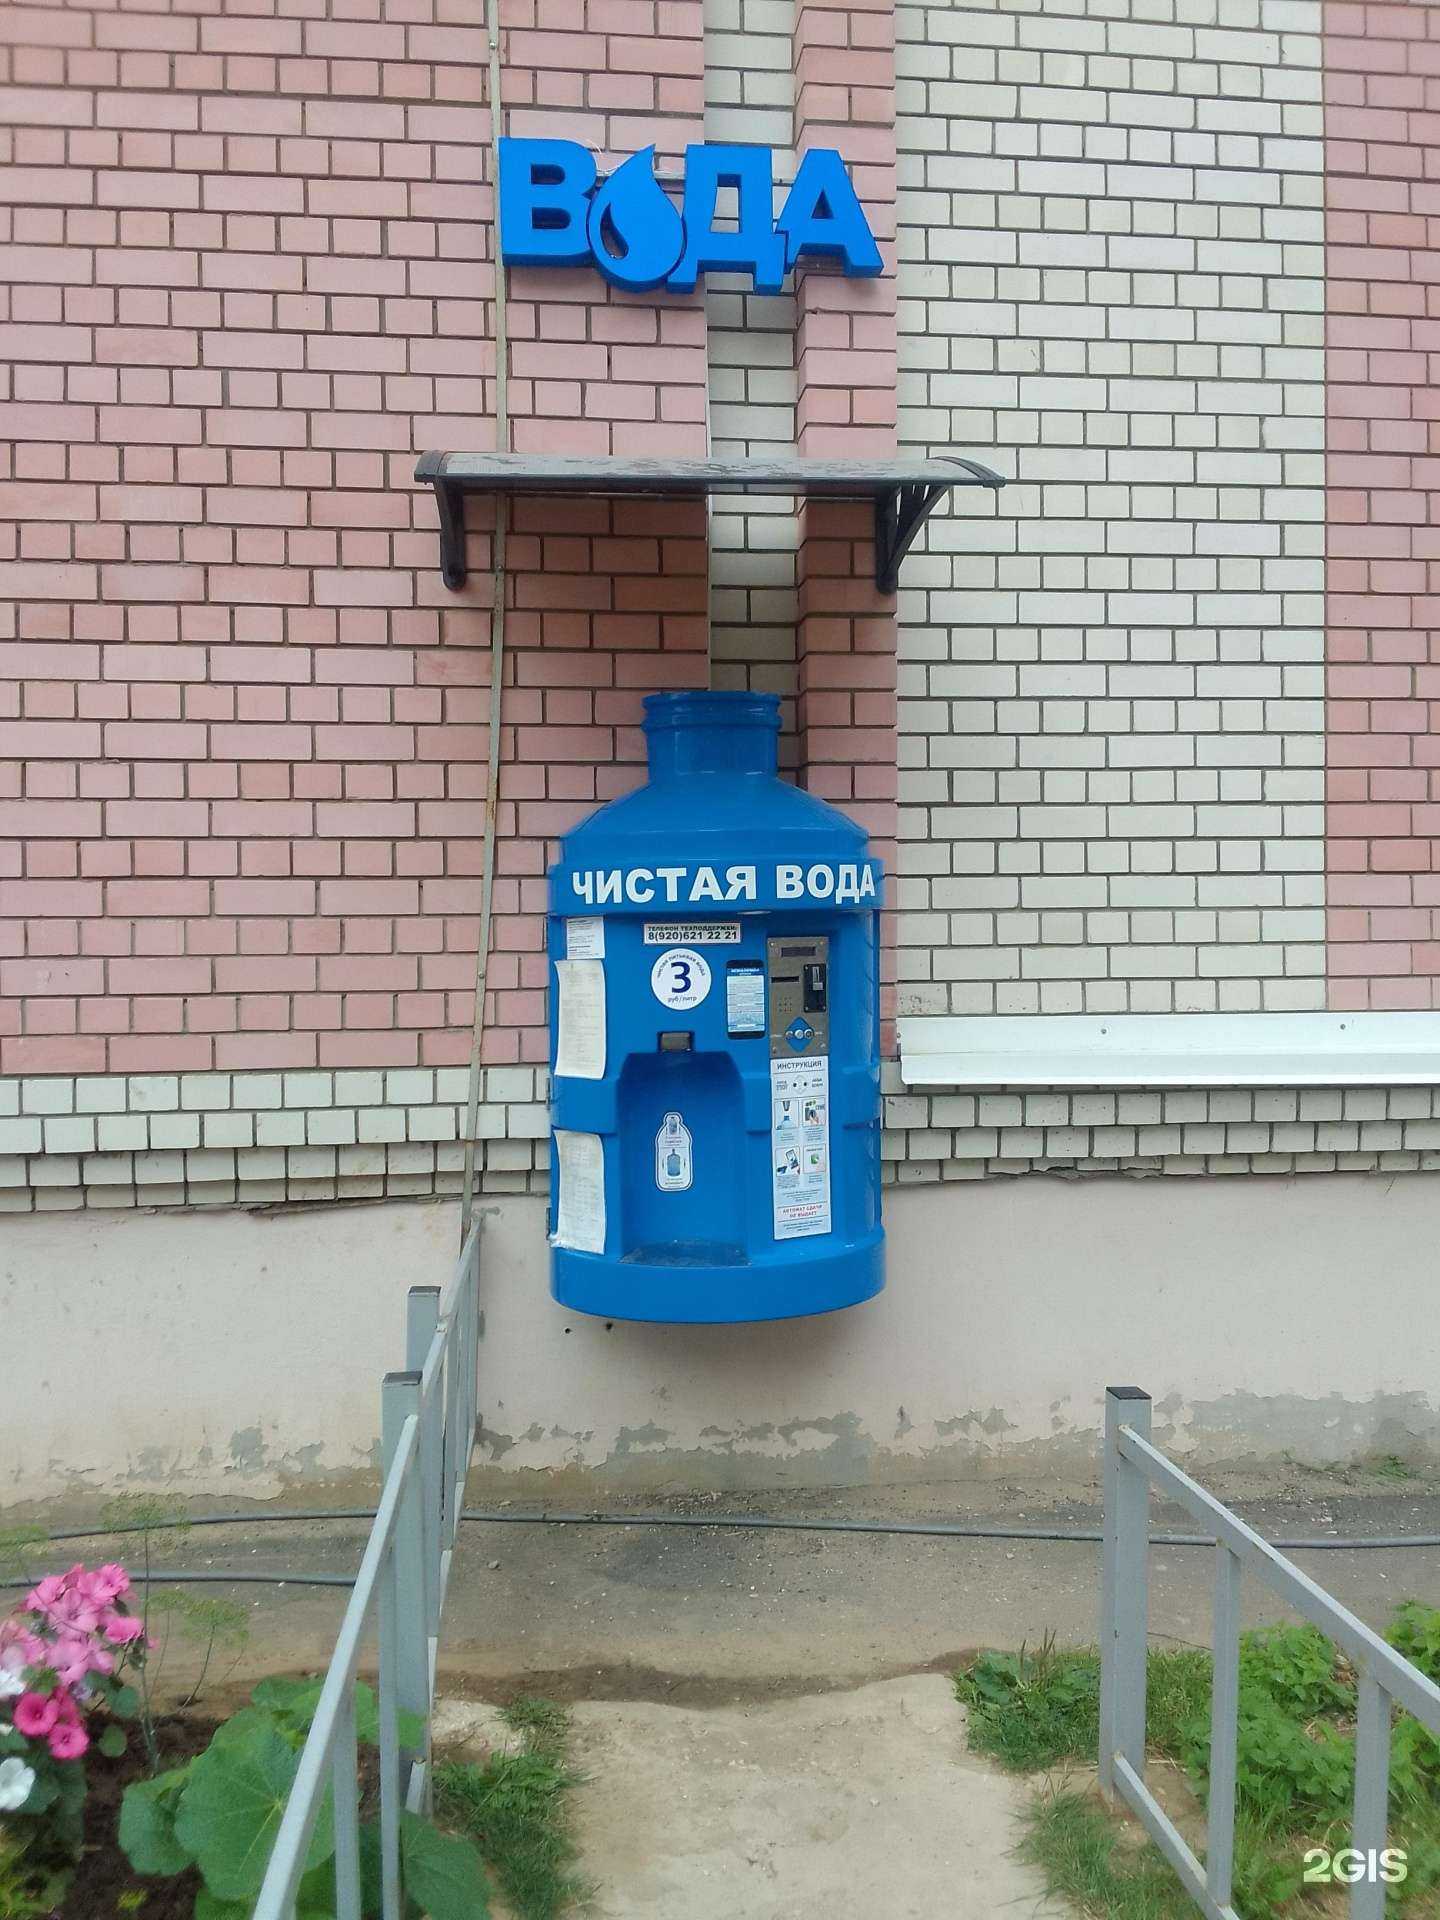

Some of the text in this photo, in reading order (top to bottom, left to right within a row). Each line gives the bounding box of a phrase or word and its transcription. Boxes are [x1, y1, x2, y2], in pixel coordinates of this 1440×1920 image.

[497, 136, 884, 295] ВОДА
[572, 864, 876, 904] ЧИСТАЯ ВОДА
[707, 931, 720, 940] 22
[725, 931, 737, 940] 21
[671, 961, 692, 993] 3
[777, 1060, 822, 1070] ИНСТРУКЦИЯ
